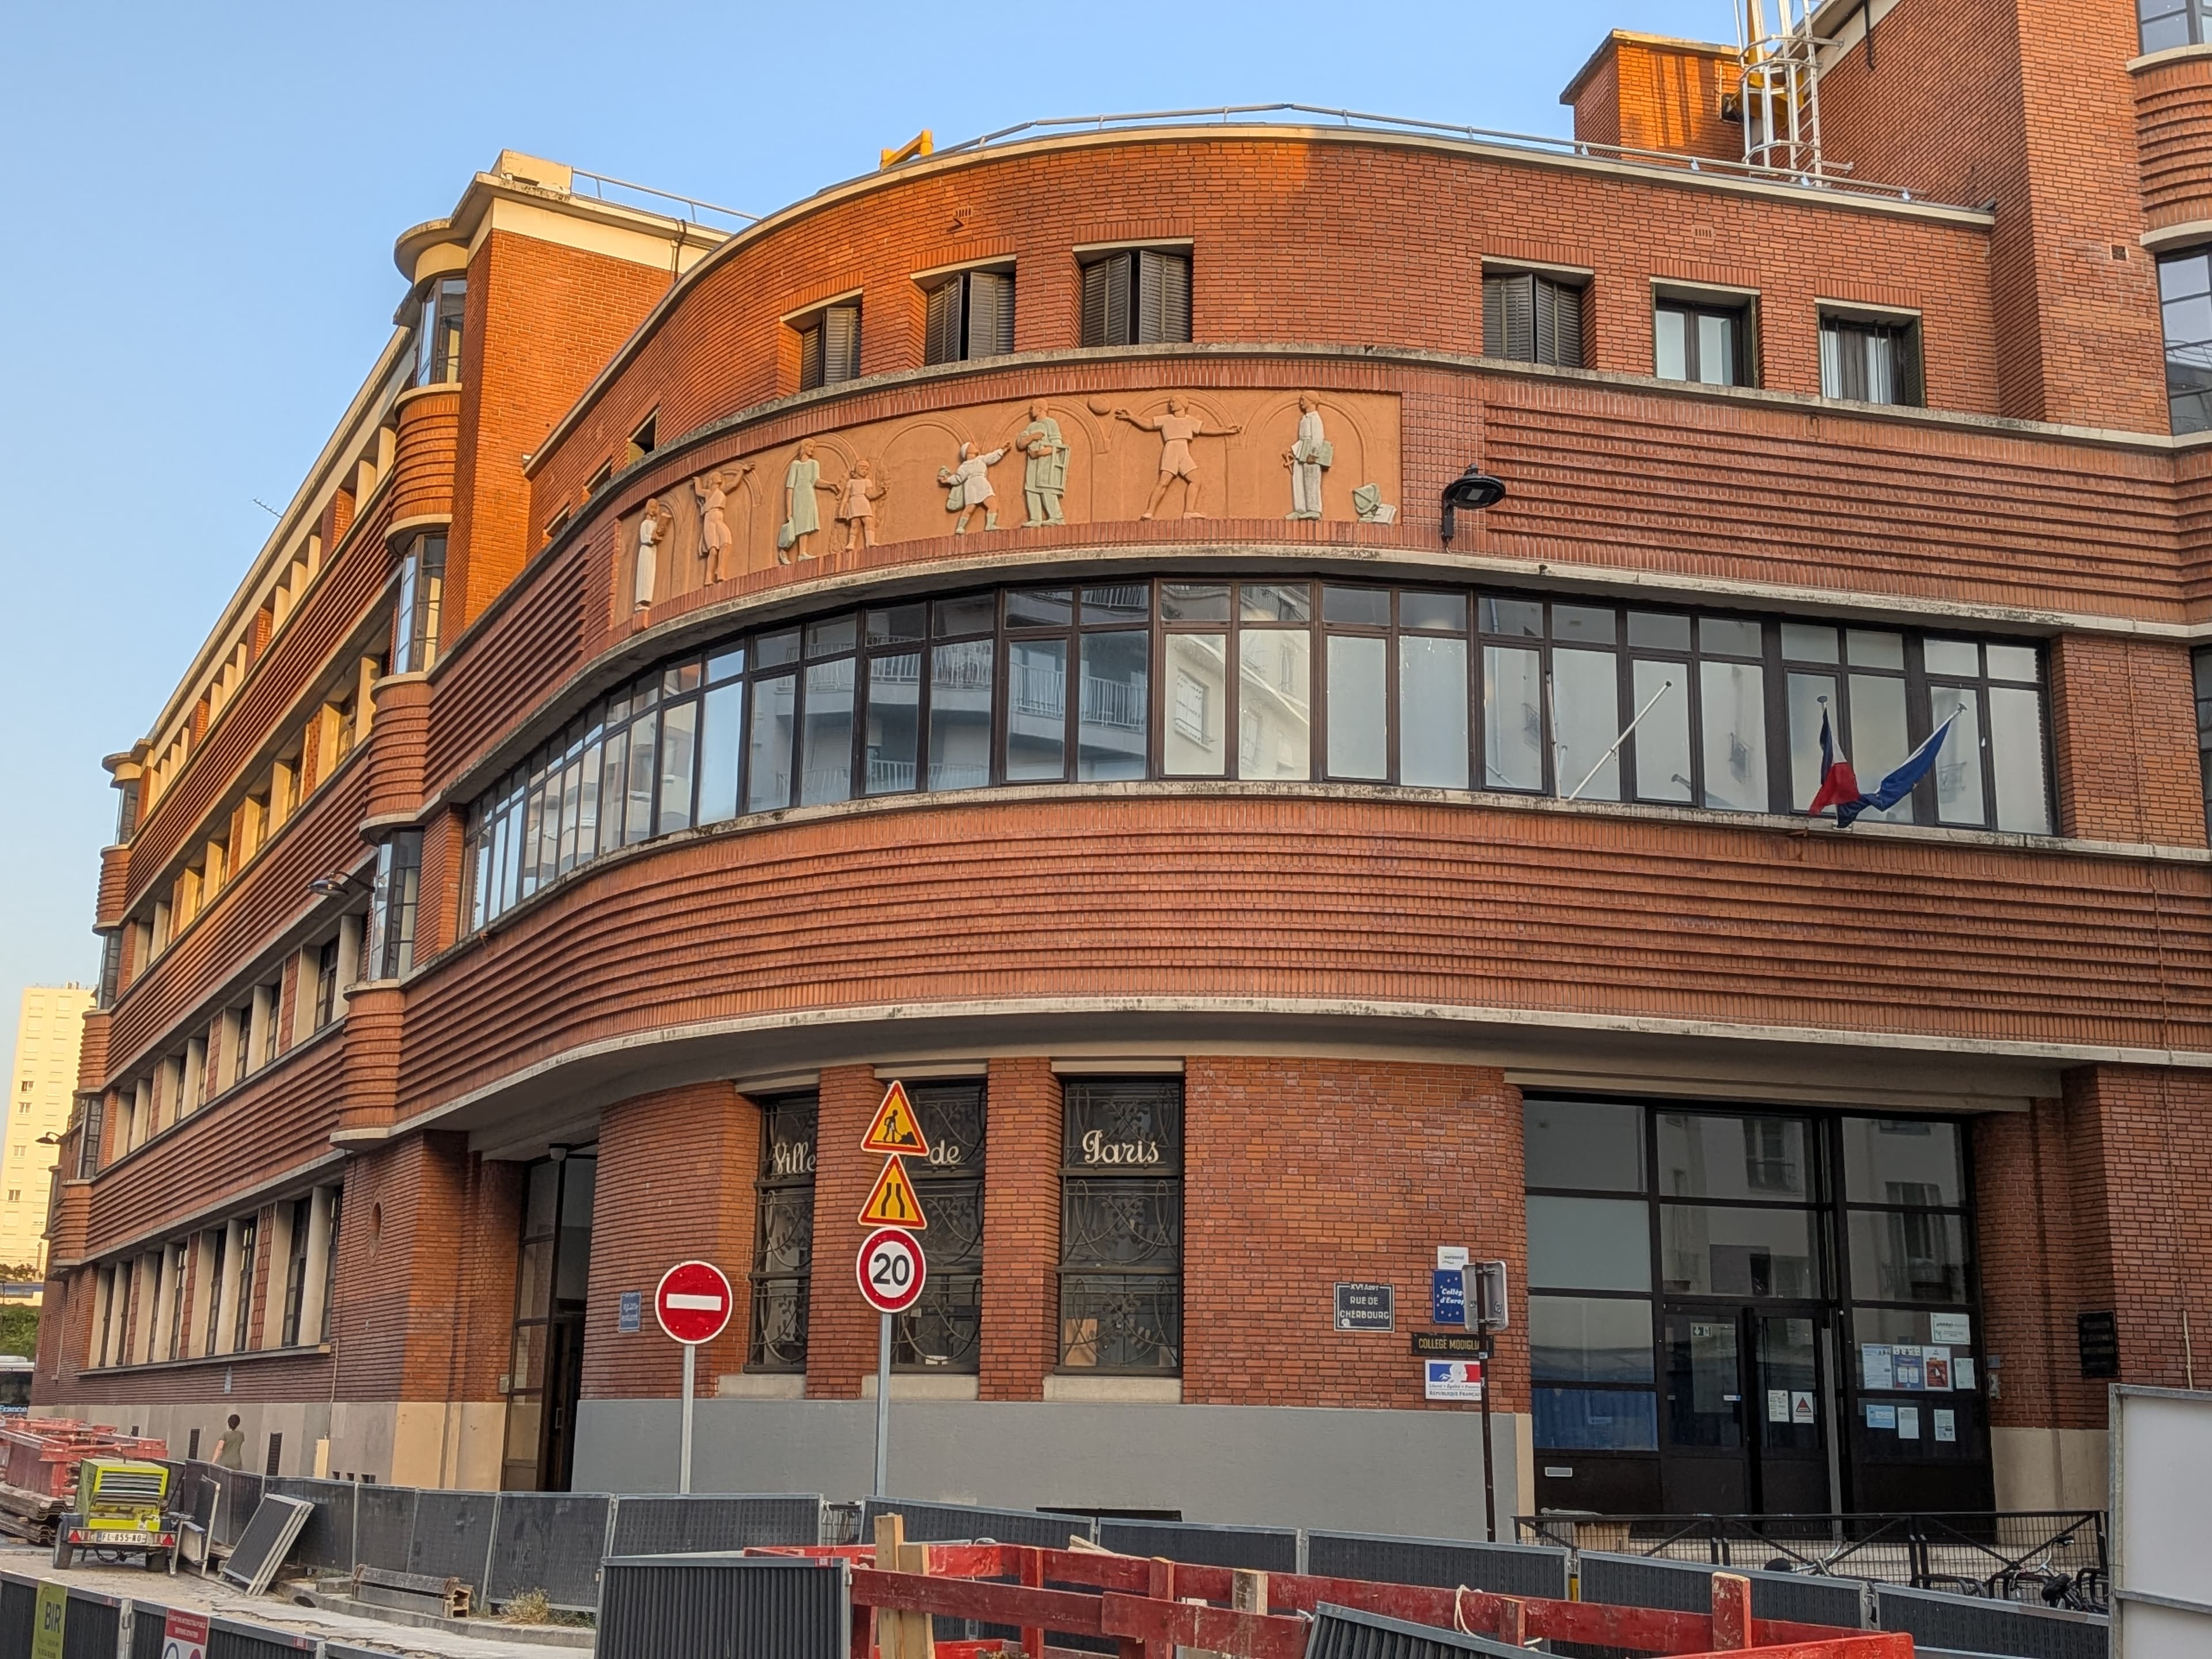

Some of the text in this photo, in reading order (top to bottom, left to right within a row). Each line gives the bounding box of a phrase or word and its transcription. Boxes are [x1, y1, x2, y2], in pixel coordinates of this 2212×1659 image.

[774, 1130, 1159, 1174] Ville de Paris
[873, 1252, 910, 1286] 20
[1442, 1288, 1464, 1296] Collèg
[1350, 1296, 1378, 1305] RUE DE
[1440, 1297, 1464, 1305] d'Europ
[1340, 1310, 1389, 1319] CHERBOURG
[1419, 1338, 1488, 1350] COLLEGE MODIGLII
[44, 1601, 61, 1633] BIR
